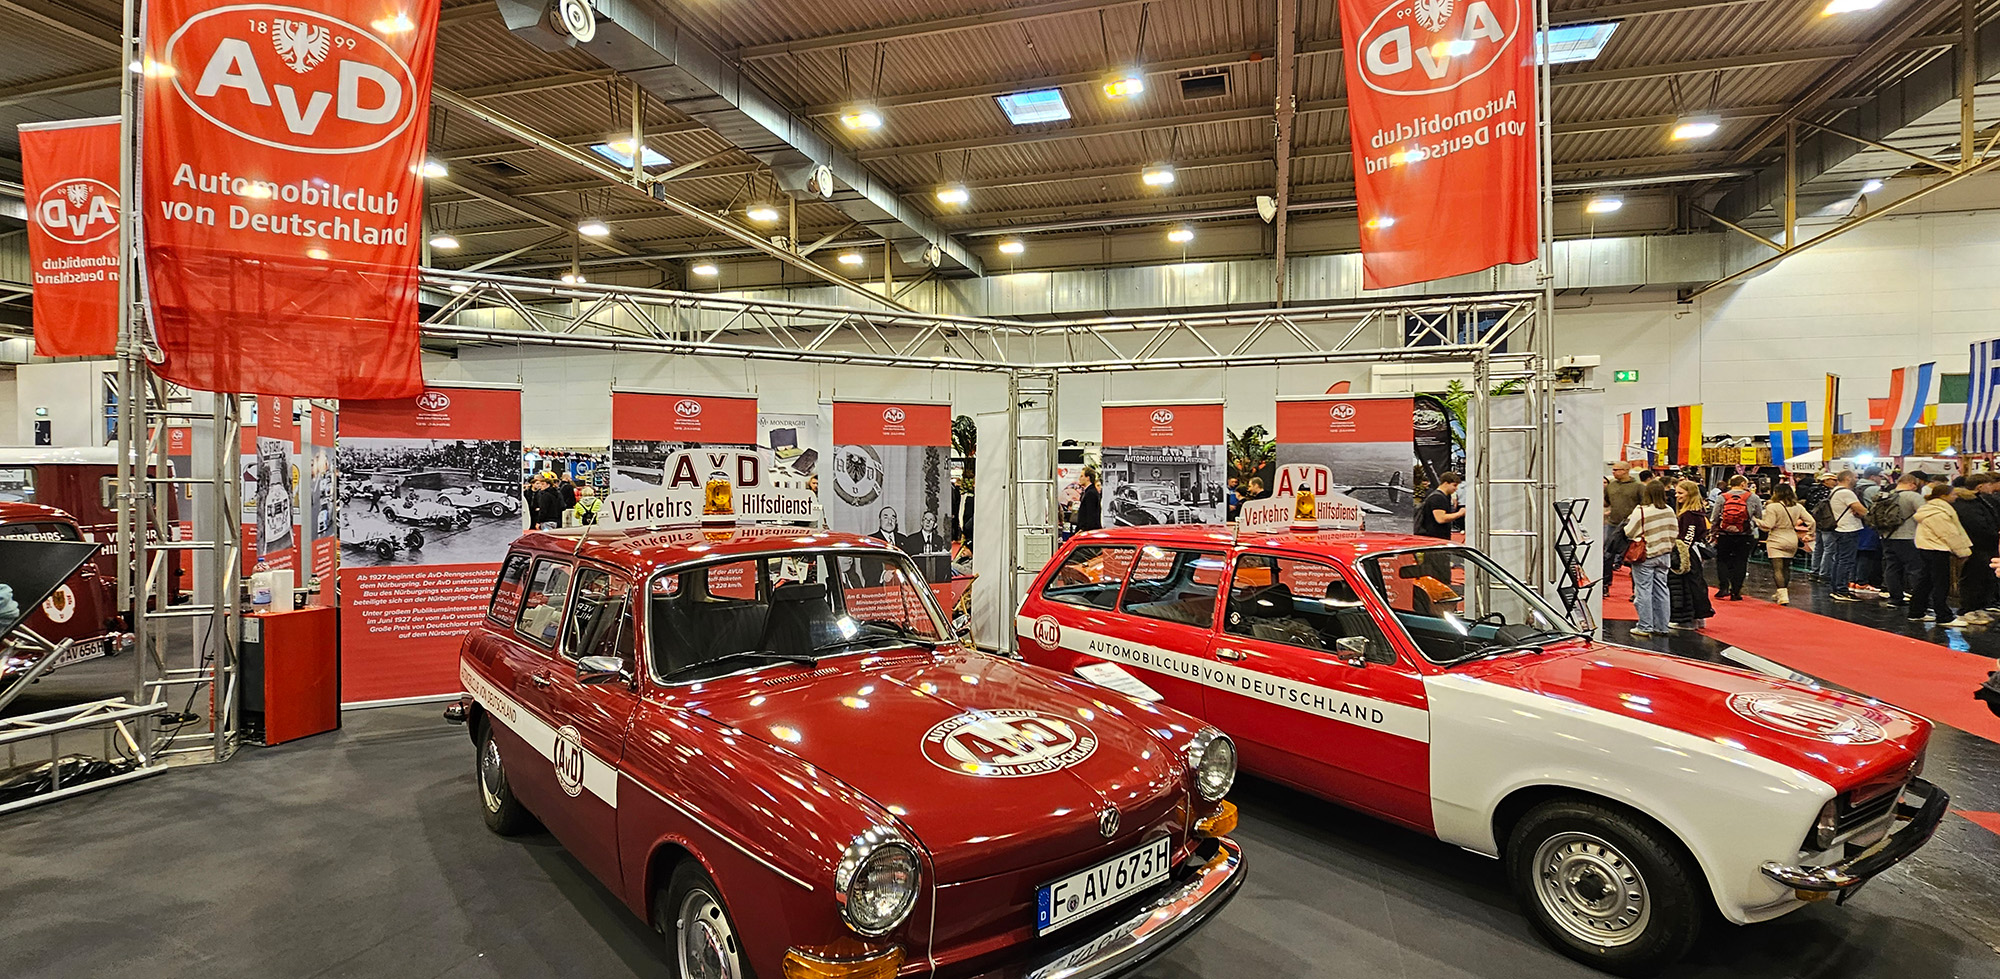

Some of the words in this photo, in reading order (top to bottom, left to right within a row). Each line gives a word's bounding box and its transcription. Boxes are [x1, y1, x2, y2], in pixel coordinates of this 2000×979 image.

[248, 18, 268, 34] 18
[334, 36, 357, 51] 99
[195, 37, 402, 136] AvD
[172, 163, 398, 215] Automobilclub
[161, 201, 215, 226] von
[229, 205, 408, 246] Deutschland
[420, 396, 448, 409] AvD
[677, 404, 699, 415] AvD
[611, 496, 692, 523] Verkehrs
[742, 494, 813, 515] Hilfsdienst
[1244, 504, 1289, 526] Verkehrs
[1317, 502, 1358, 521] Hilfsdienst
[377, 581, 421, 589] Nürburgring.
[452, 577, 492, 585] unterstützte
[387, 573, 414, 581] beginnt
[427, 570, 495, 579] AvD-Renngeschichte
[412, 606, 477, 614] Publikumsinteresse
[426, 621, 468, 629] Deutschland
[1039, 623, 1055, 642] AvD
[1089, 640, 1199, 677] AUTOMOBILCLUB
[1203, 667, 1236, 687] VON
[1241, 677, 1384, 724] DEUTSCHLAND
[559, 740, 578, 782] AvD
[1040, 910, 1047, 921] D
[1053, 882, 1068, 918] F
[1083, 865, 1112, 905] AV
